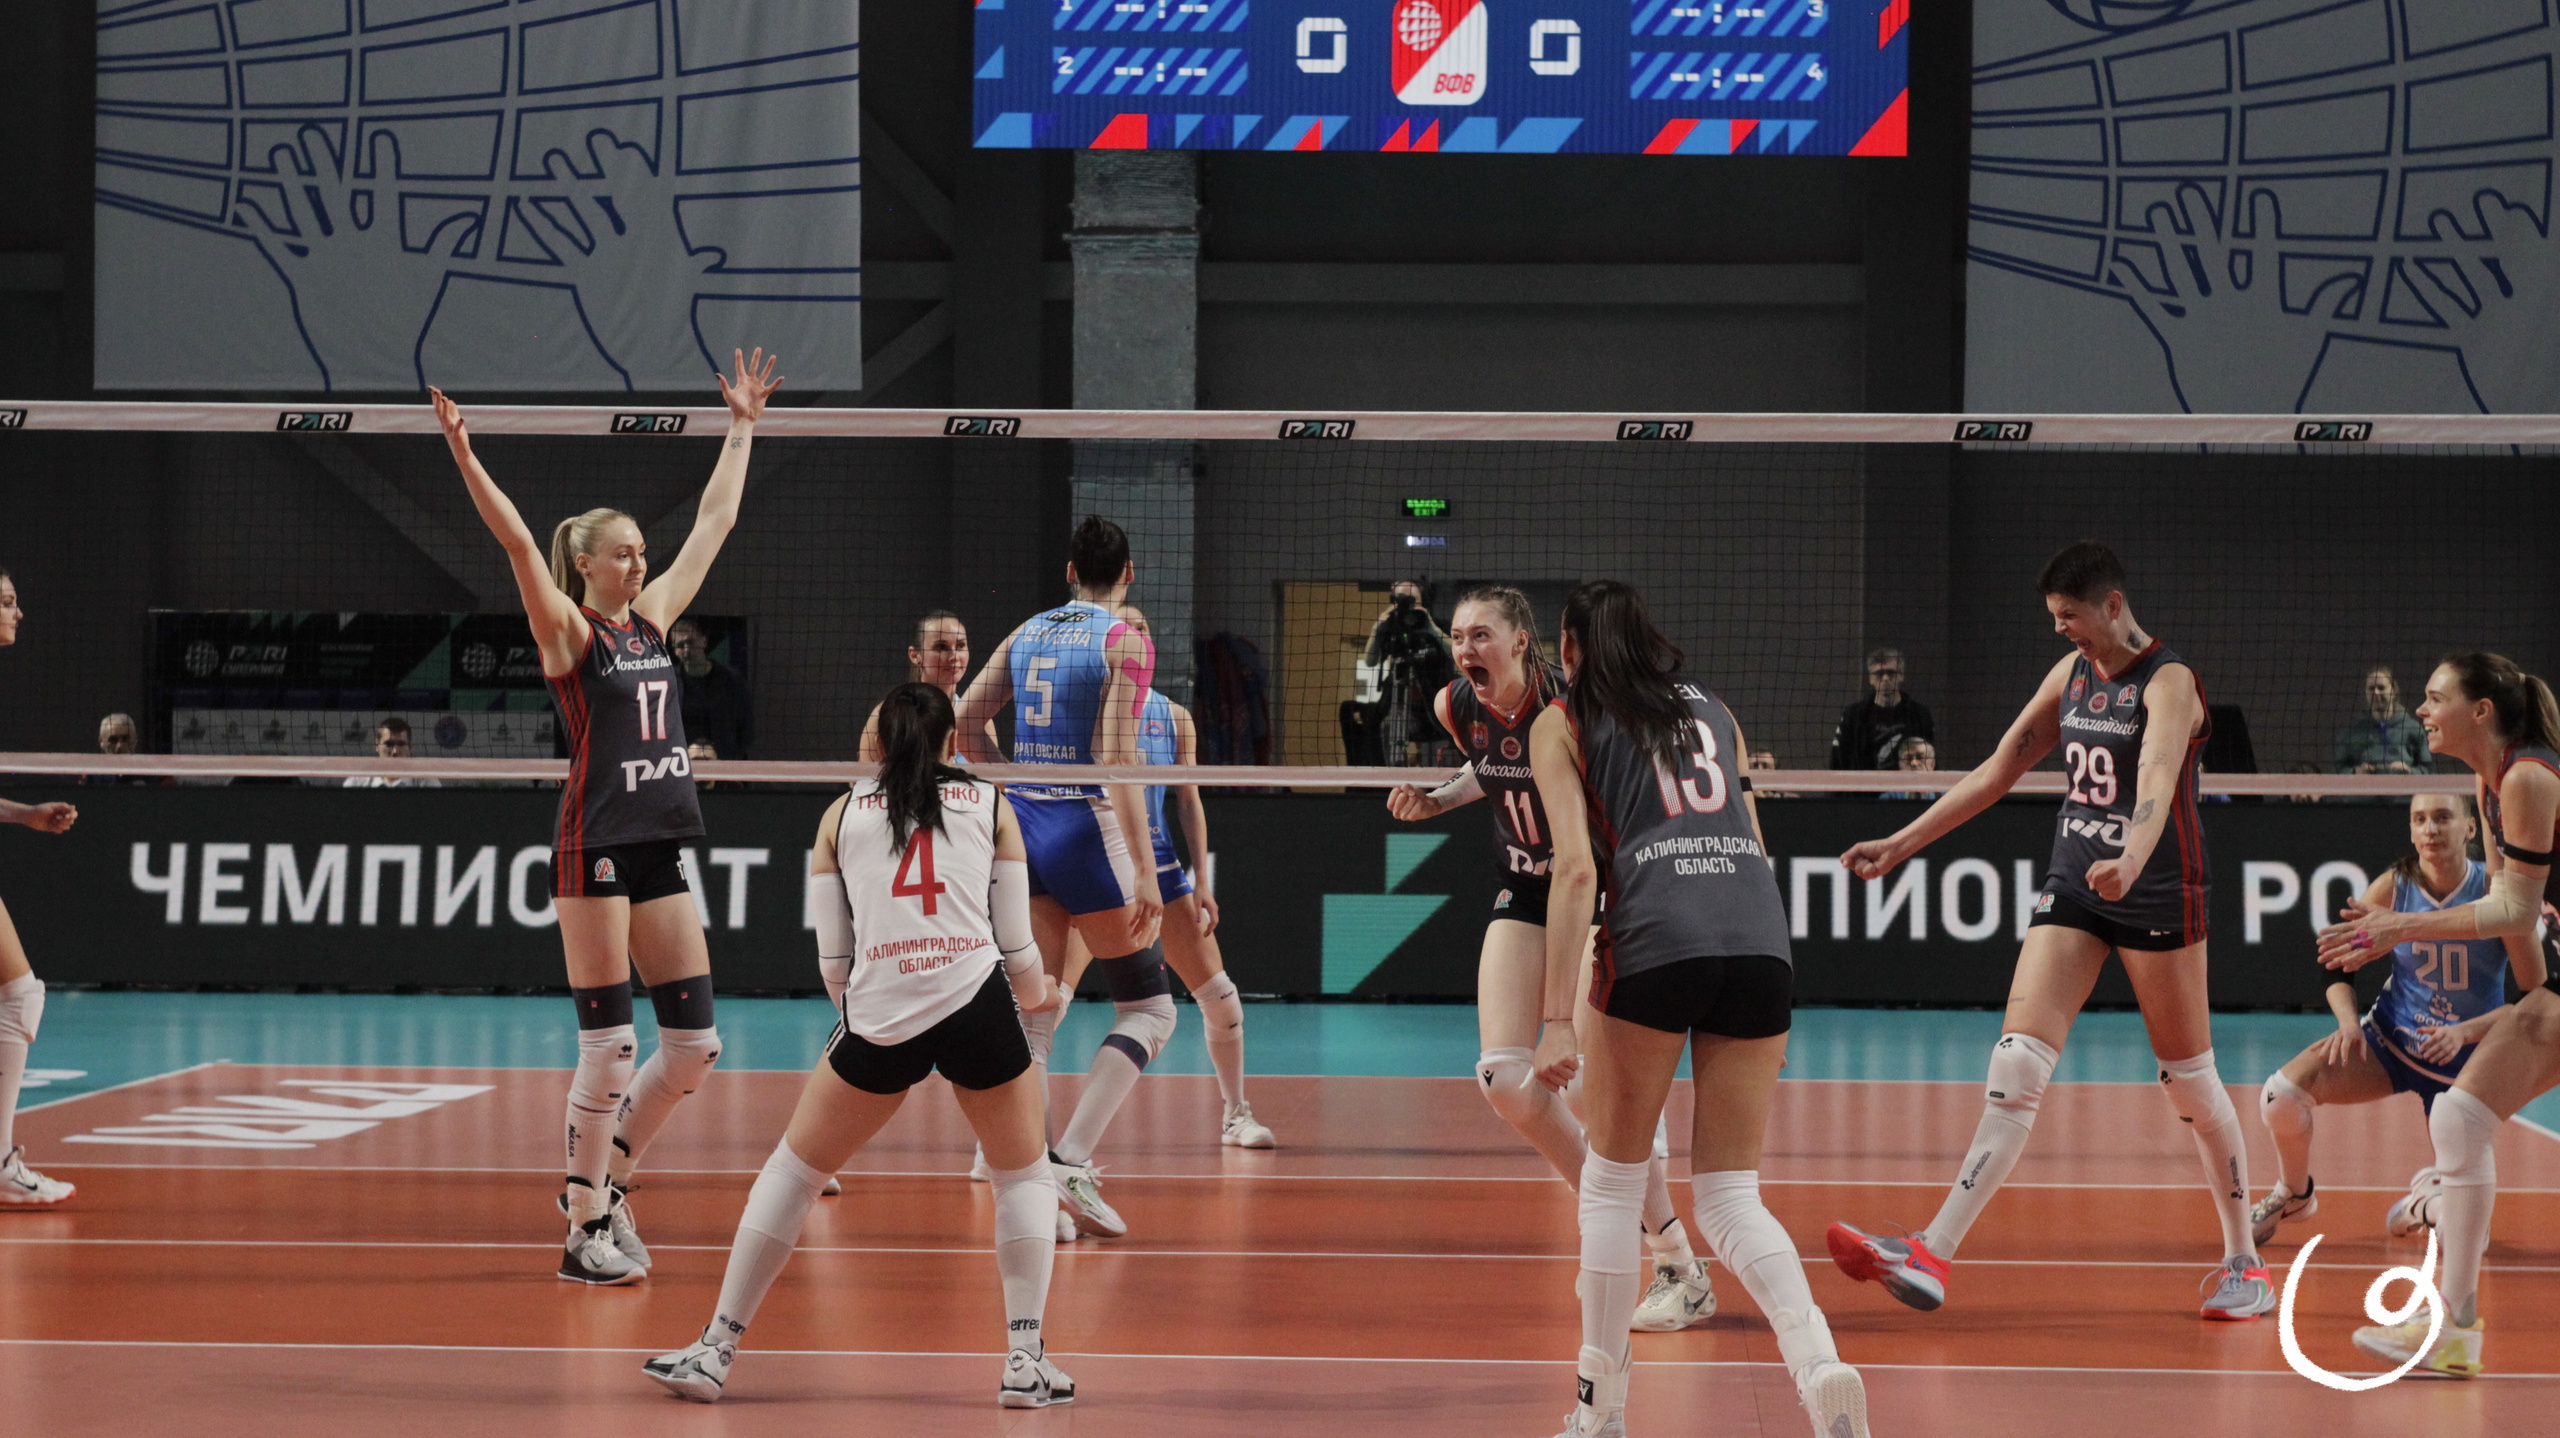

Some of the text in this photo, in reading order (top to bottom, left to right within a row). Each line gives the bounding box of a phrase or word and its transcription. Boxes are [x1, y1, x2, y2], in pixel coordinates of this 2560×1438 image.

[1058, 56, 1074, 74] 2
[1807, 62, 1823, 81] 4
[1433, 73, 1475, 94] ВФВ
[283, 413, 349, 430] PARI
[616, 415, 684, 432] PARI
[950, 419, 1017, 436] PARI
[1285, 421, 1351, 438] PARI
[1622, 422, 1690, 439] PARI
[1962, 423, 2028, 440] PARI
[2300, 424, 2368, 440] PARI
[1025, 656, 1058, 728] 5
[636, 680, 669, 741] 17
[1650, 718, 1729, 818] 13
[2065, 742, 2118, 806] 29
[1504, 790, 1541, 846] 11
[1635, 836, 1762, 866] КАЛИНИНГРАДСКАЯ
[892, 825, 946, 917] 4
[1674, 857, 1736, 875] ОБЛАСТЬ
[2412, 941, 2469, 991] 20
